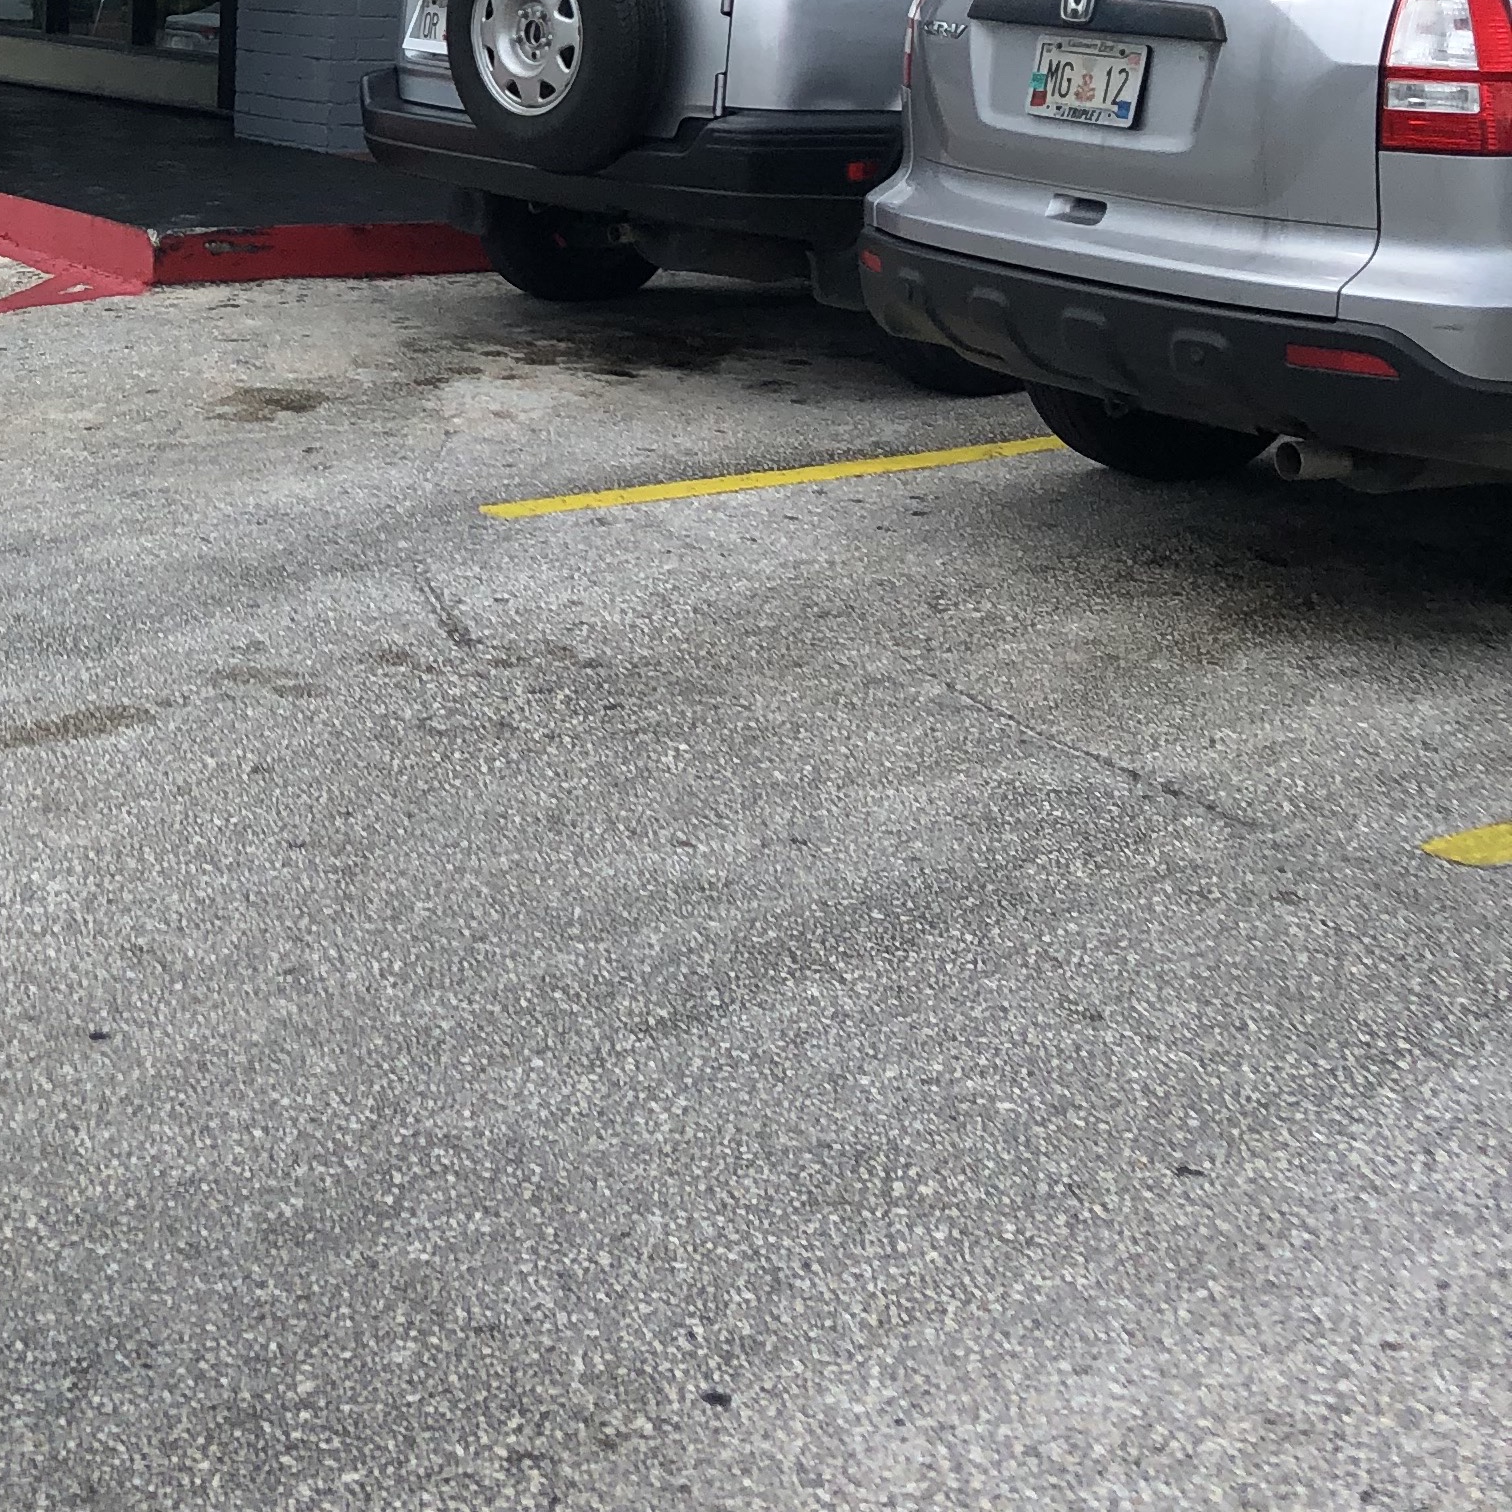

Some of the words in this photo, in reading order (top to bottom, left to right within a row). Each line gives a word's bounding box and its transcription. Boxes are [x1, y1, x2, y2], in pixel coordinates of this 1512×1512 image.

[423, 11, 440, 40] OR
[1045, 58, 1075, 98] MG
[1102, 65, 1130, 105] 12
